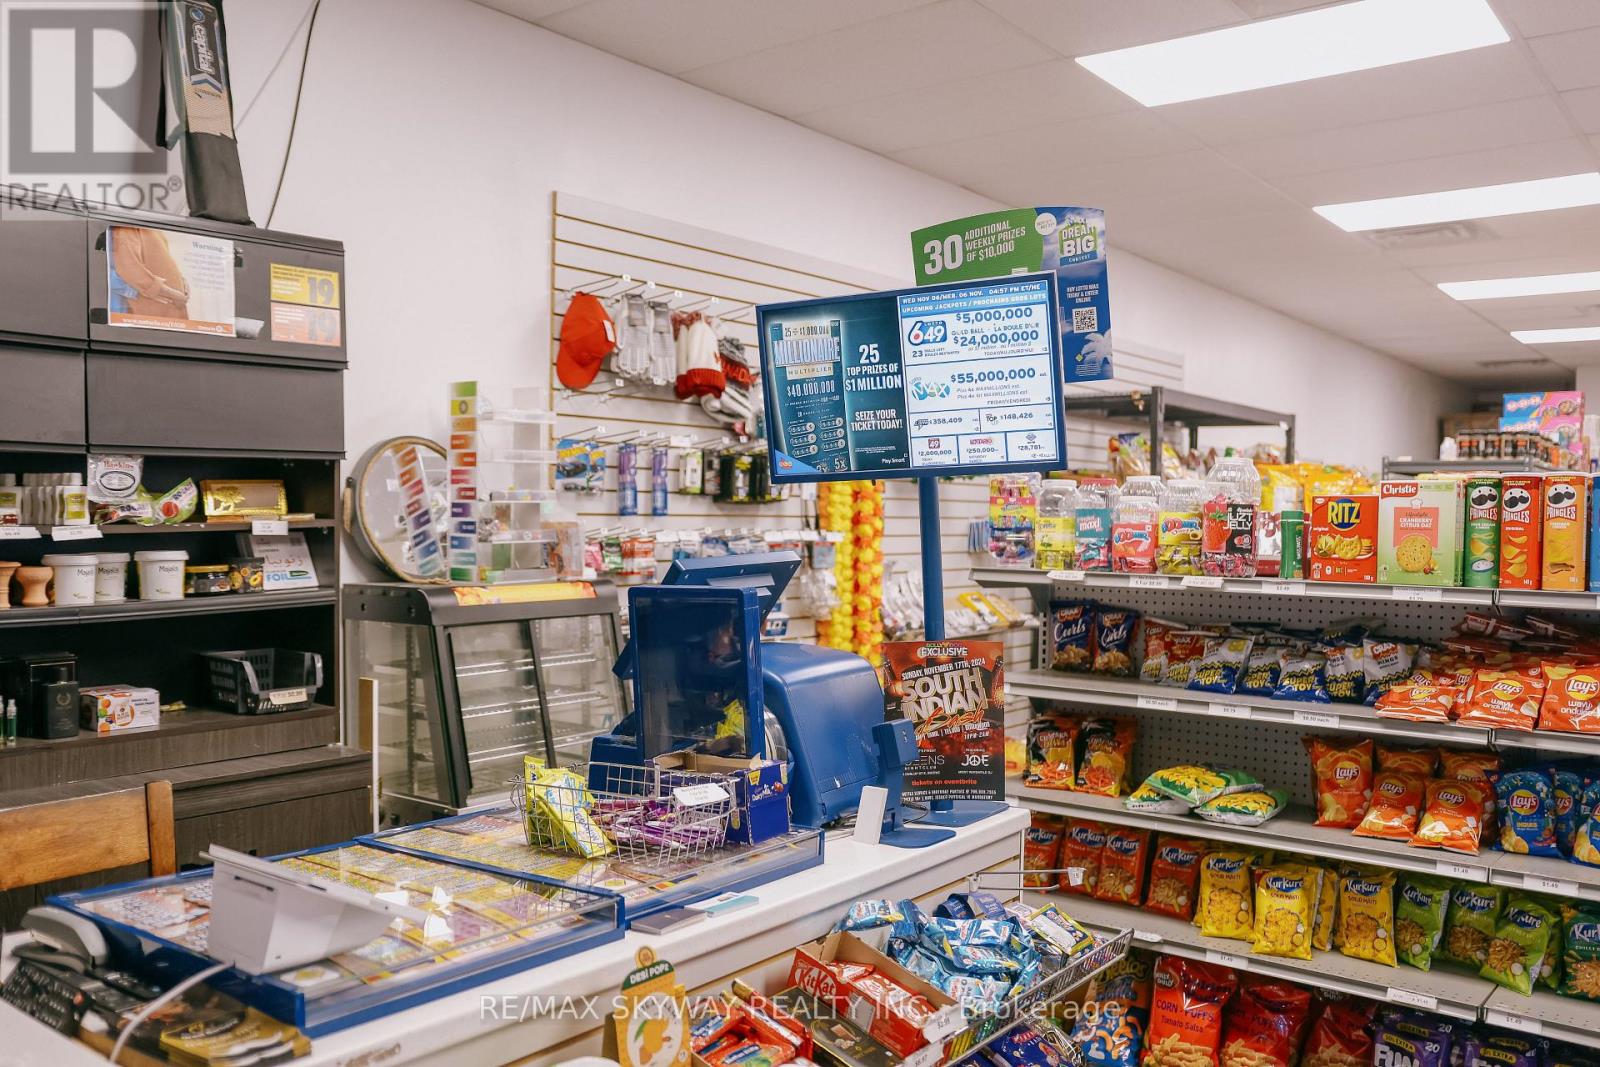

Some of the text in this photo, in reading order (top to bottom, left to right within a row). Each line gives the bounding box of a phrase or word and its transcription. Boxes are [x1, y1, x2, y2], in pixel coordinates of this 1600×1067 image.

[965, 221, 1010, 240] ADDITIONAL
[1063, 224, 1094, 239] DREAM
[924, 226, 1025, 275] 30 WEEKLY PRIZES
[967, 242, 1014, 262] OF $10,000
[1063, 235, 1094, 257] BIG
[307, 276, 335, 306] 19
[974, 298, 1009, 306] PROCHAINS
[956, 307, 1032, 324] $5,000,000
[954, 330, 1038, 347] $24,000,000
[859, 344, 880, 364] 25
[847, 363, 898, 376] TOP PRIZES OF
[951, 368, 1035, 384] $55,000,000
[845, 375, 902, 391] $1 MILLION
[855, 409, 896, 421] SEIZE YOUR
[851, 418, 903, 431] TICKET TODAY!
[1383, 484, 1417, 494] Christie
[1328, 502, 1361, 524] RITZ
[1470, 508, 1498, 521] PRINGLES
[1504, 510, 1529, 523] PRINGLES
[1547, 506, 1576, 520] PRINGLES
[1054, 619, 1086, 641] Curls
[1101, 624, 1127, 647] Curls
[921, 648, 968, 656] EXCLUSIVE
[924, 664, 954, 676] NOVEMBER
[971, 657, 985, 667] 2024
[1195, 668, 1222, 678] SUPER
[901, 667, 981, 702] SOUTH
[1201, 676, 1217, 685] TOY
[1295, 683, 1312, 691] TOY
[1568, 680, 1597, 694] Lay's
[1493, 682, 1522, 694] Lay's
[901, 689, 988, 722] INDIAN
[1491, 698, 1514, 708] wavy
[1568, 701, 1593, 710] wavy
[961, 754, 990, 766] JOE
[1336, 768, 1358, 779] Lay's
[1380, 782, 1404, 794] Lay's
[1439, 792, 1464, 803] Lay's
[1513, 795, 1536, 808] Lay's
[1106, 835, 1140, 850] Kurkure
[1161, 847, 1197, 865] Kurkure
[1209, 859, 1244, 871] Kurkure
[1266, 877, 1304, 891] Kurkure
[1347, 880, 1381, 894] Kurkure
[630, 968, 649, 984] DESI
[800, 967, 835, 997] KitKat
[1156, 999, 1214, 1024] CORN PUFFS
[1161, 1015, 1204, 1033] Tomato Salsa
[1438, 1023, 1452, 1032] 20
[1425, 1042, 1440, 1054] 20
